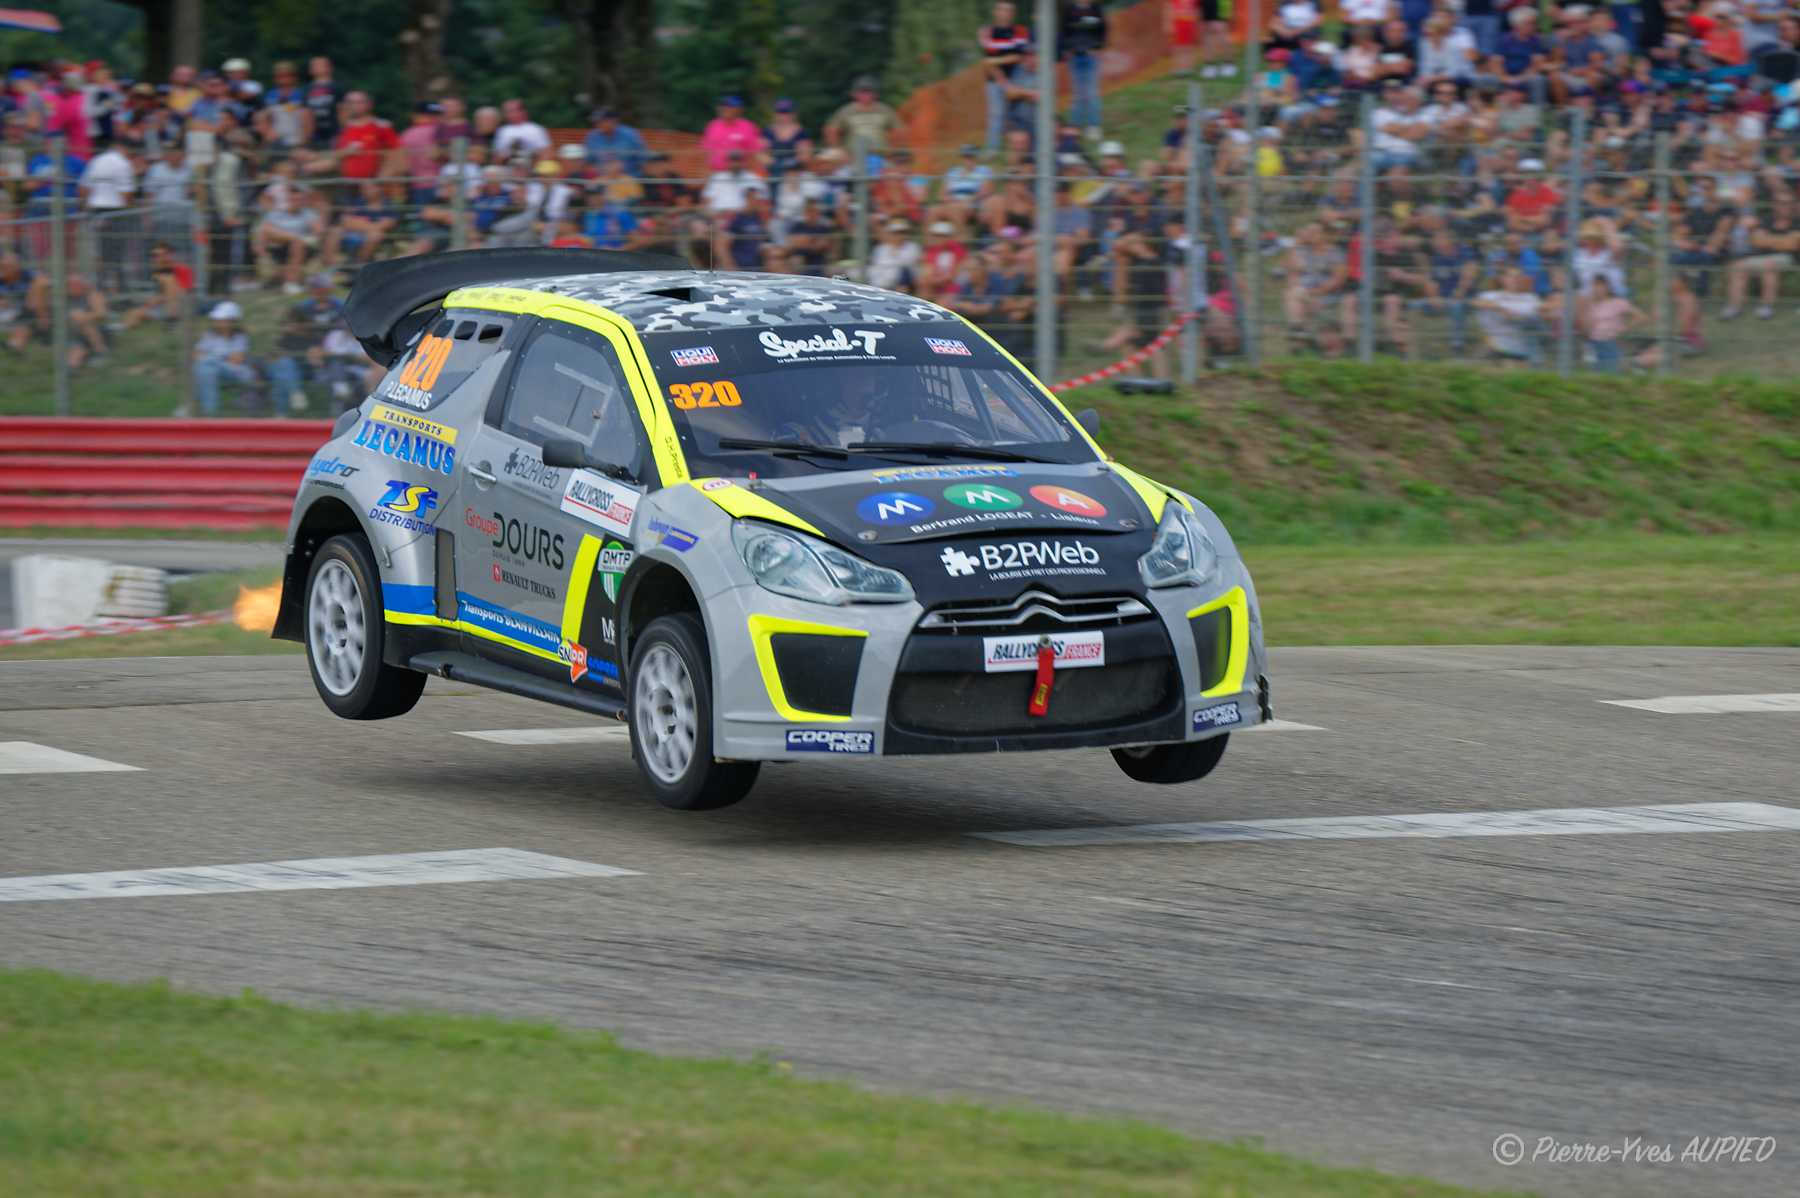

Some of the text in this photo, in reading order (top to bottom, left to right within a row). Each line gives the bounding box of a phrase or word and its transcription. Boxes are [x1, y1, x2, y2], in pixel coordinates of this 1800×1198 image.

[671, 347, 714, 358] LIQUI
[758, 328, 886, 359] Special-T
[925, 338, 966, 348] LIQUI
[931, 345, 971, 355] MOLY
[400, 333, 453, 392] 320
[677, 355, 719, 366] MOLY
[669, 380, 742, 410] 320
[383, 409, 443, 436] TRANSPORTS
[350, 419, 457, 476] LECAMUS
[464, 506, 499, 537] Groupe
[910, 515, 976, 534] Bertrand
[602, 550, 632, 565] DMTP
[979, 540, 1101, 571] B2PWeb
[993, 641, 1065, 660] RALLYCSS
[1193, 703, 1238, 723] COOPER
[788, 730, 872, 744] COOPER
